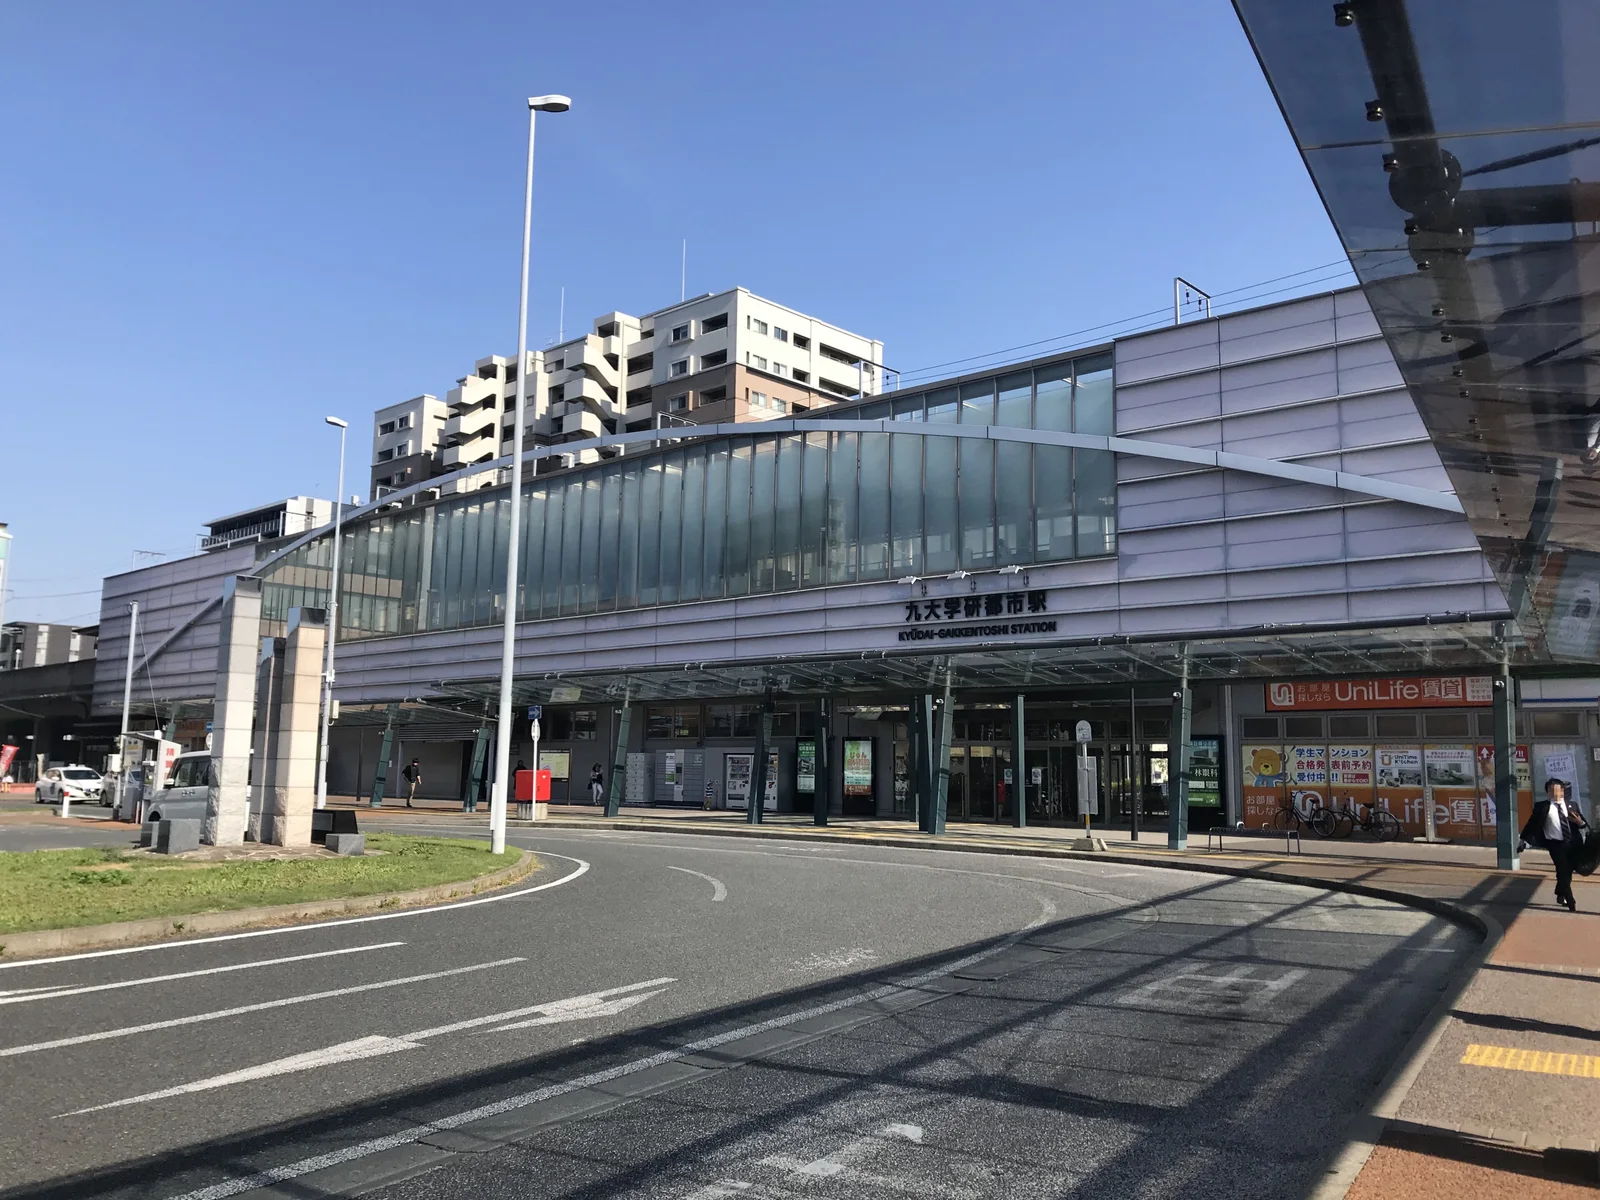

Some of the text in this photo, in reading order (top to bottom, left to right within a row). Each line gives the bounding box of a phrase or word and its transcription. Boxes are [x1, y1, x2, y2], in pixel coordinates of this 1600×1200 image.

[905, 591, 1047, 622] 九大学研都市駅
[1011, 621, 1057, 634] STATION
[1335, 679, 1419, 702] UniLife
[1422, 678, 1462, 698] 賃貸
[1298, 693, 1331, 702] 探しなら
[1296, 748, 1369, 758] 学生マンション
[1296, 760, 1372, 770] 合格発表前予約
[1246, 795, 1276, 805] お部屋
